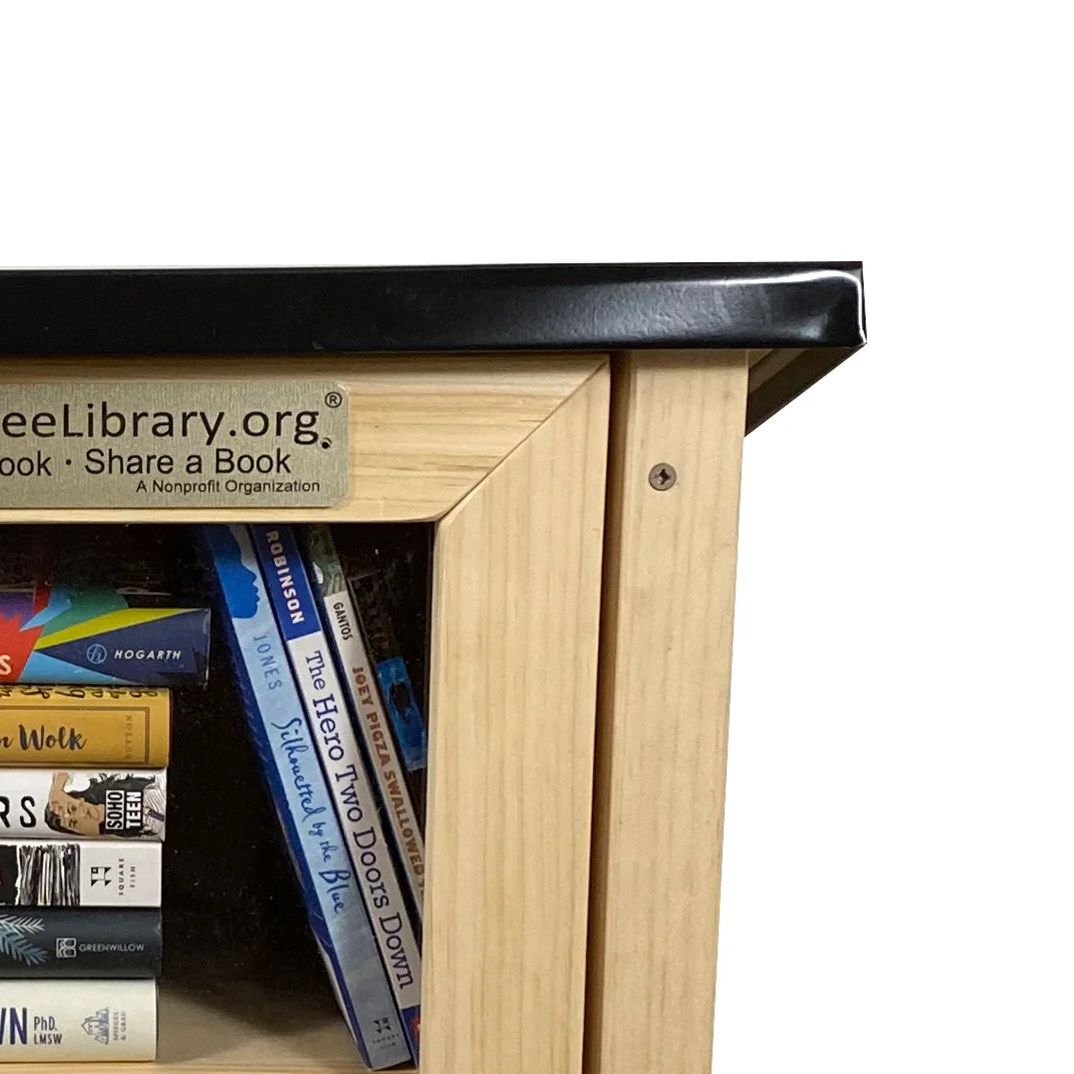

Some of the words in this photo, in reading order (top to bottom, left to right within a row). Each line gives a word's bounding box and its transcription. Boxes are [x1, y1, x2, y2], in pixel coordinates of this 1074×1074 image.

[84, 448, 174, 475] Share
[185, 453, 202, 475] a
[215, 448, 292, 474] Book
[135, 481, 148, 493] A
[152, 480, 220, 495] Nonprofit
[225, 480, 321, 495] Organization
[265, 530, 305, 625] ROBINSON
[332, 602, 353, 641] GANTOS
[114, 649, 182, 661] HOGARTH
[253, 634, 283, 691] JONES
[306, 650, 326, 691] The
[18, 724, 87, 751] Wolk
[312, 693, 344, 762] Hero
[270, 717, 327, 823] Silhouetted
[352, 666, 375, 709] JOEY
[366, 711, 392, 766] PIGZA
[383, 769, 425, 876] SWALLOWED
[107, 791, 124, 829] SOHO
[126, 792, 142, 829] TEEN
[334, 764, 363, 823] Two
[308, 821, 327, 837] by
[318, 841, 339, 863] the
[353, 826, 390, 910] Doors
[318, 869, 351, 914] Blue
[79, 943, 145, 952] GREENWILLOW
[379, 911, 414, 989] Down
[33, 1034, 62, 1045] LMSW
